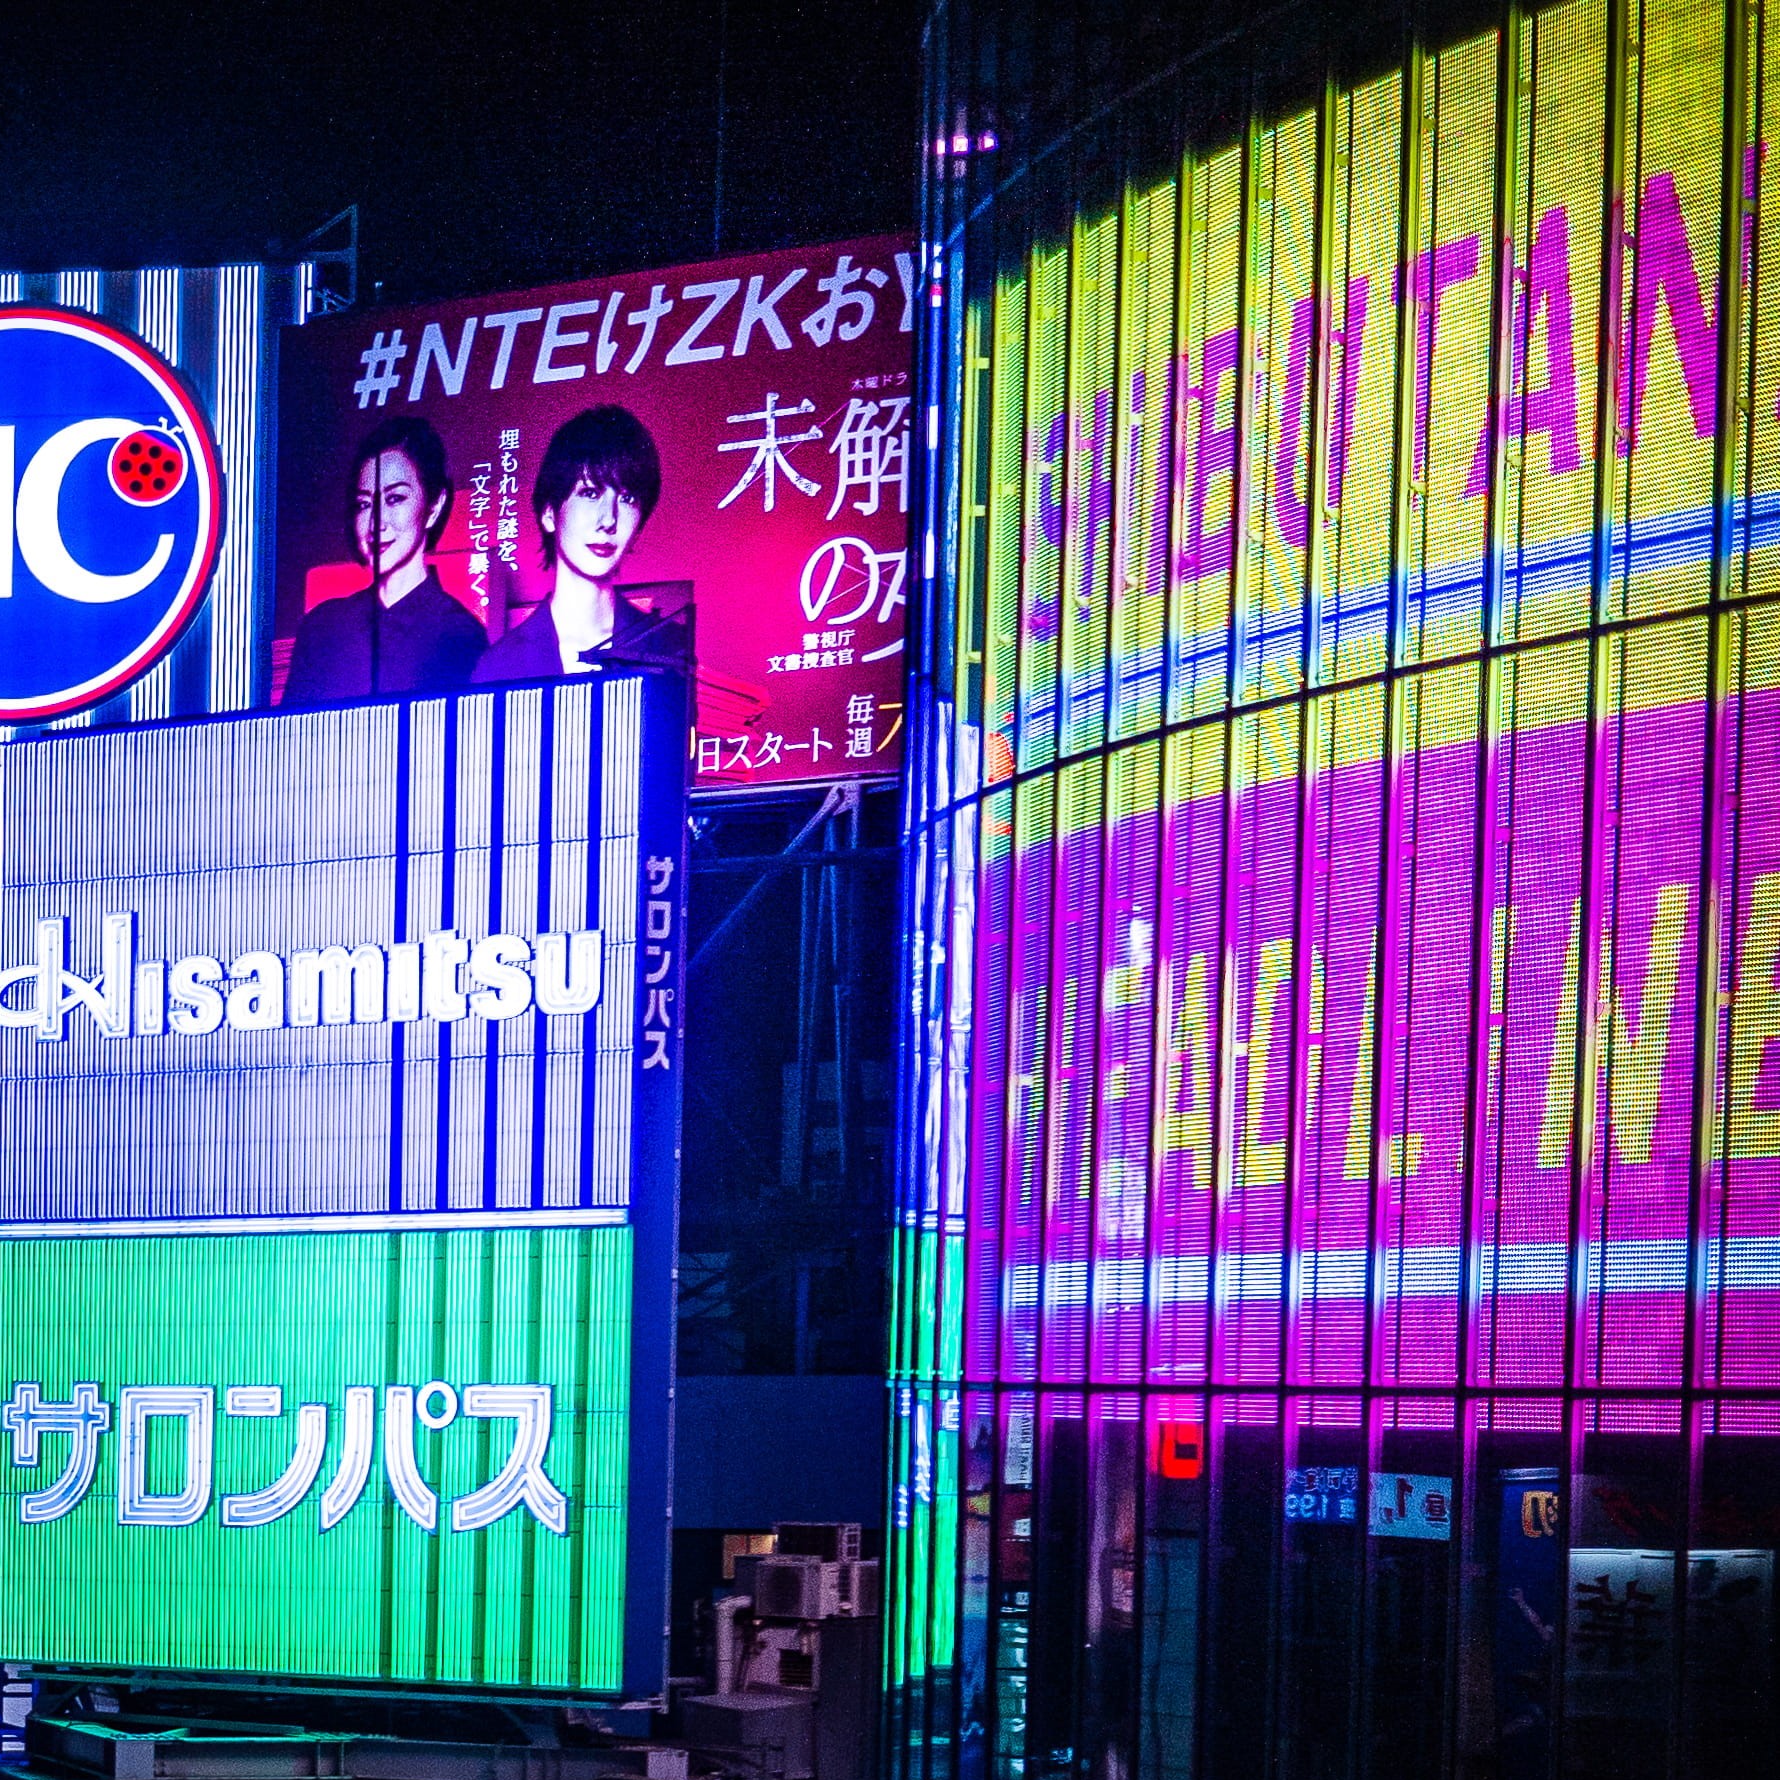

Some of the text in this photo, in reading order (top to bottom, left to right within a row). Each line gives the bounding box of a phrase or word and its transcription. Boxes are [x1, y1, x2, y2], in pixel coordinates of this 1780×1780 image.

[496, 427, 521, 573] 埋もれた謎を、
[801, 629, 856, 651] 警視庁
[641, 855, 676, 1070] サロンパス
[1, 1378, 571, 1538] サロンパス
